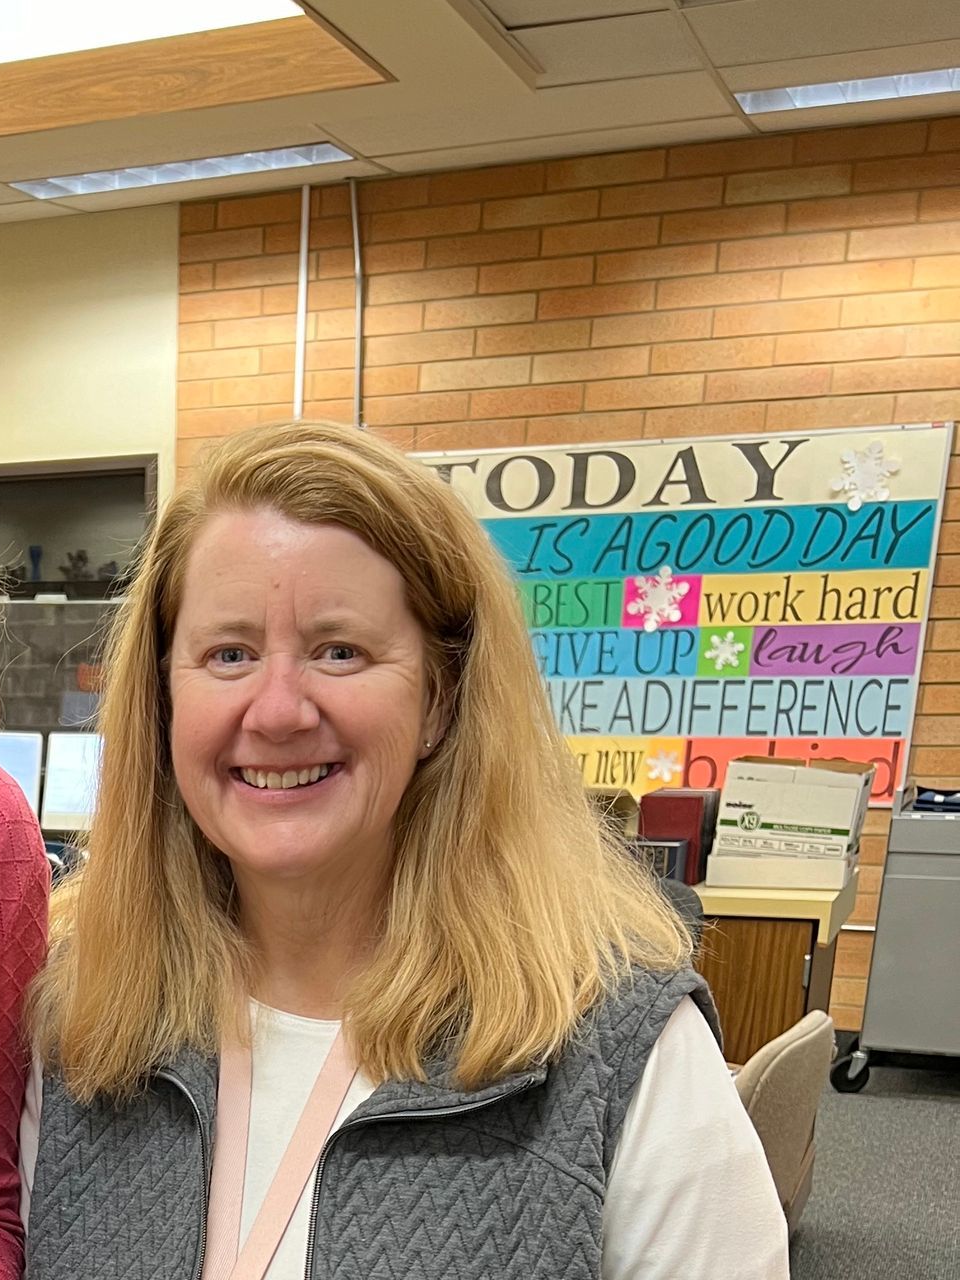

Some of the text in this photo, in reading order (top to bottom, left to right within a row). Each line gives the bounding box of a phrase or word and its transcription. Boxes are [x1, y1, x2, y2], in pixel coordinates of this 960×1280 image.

[517, 517, 590, 575] IS
[798, 504, 933, 567] DAY
[532, 581, 621, 628] BEST
[703, 570, 922, 623] work hard
[633, 628, 696, 676] UP
[753, 626, 913, 674] laugh
[593, 750, 645, 785] new
